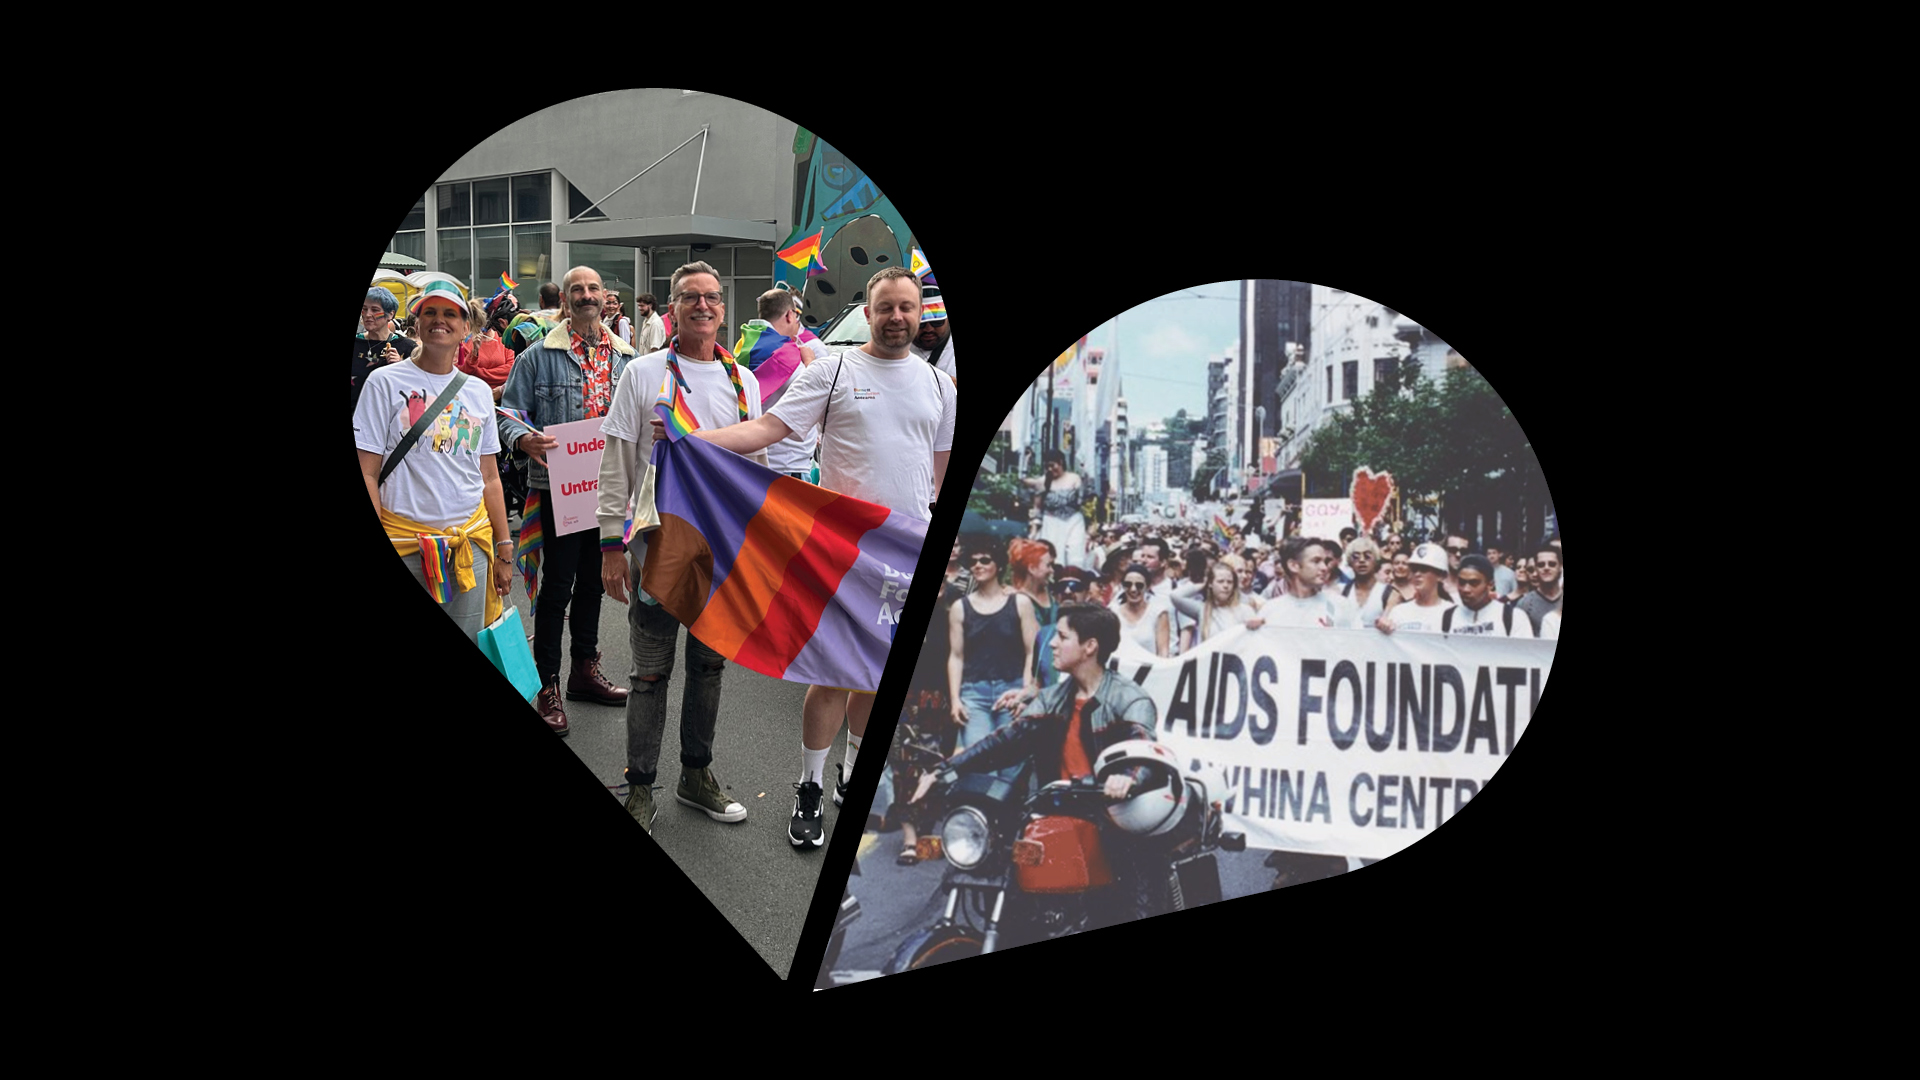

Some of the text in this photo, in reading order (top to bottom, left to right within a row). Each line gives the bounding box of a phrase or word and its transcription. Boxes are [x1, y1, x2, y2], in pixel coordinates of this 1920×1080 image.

[566, 437, 606, 456] Unde
[1163, 651, 1279, 746] AIDS
[1190, 758, 1489, 830] HINA CENTR
